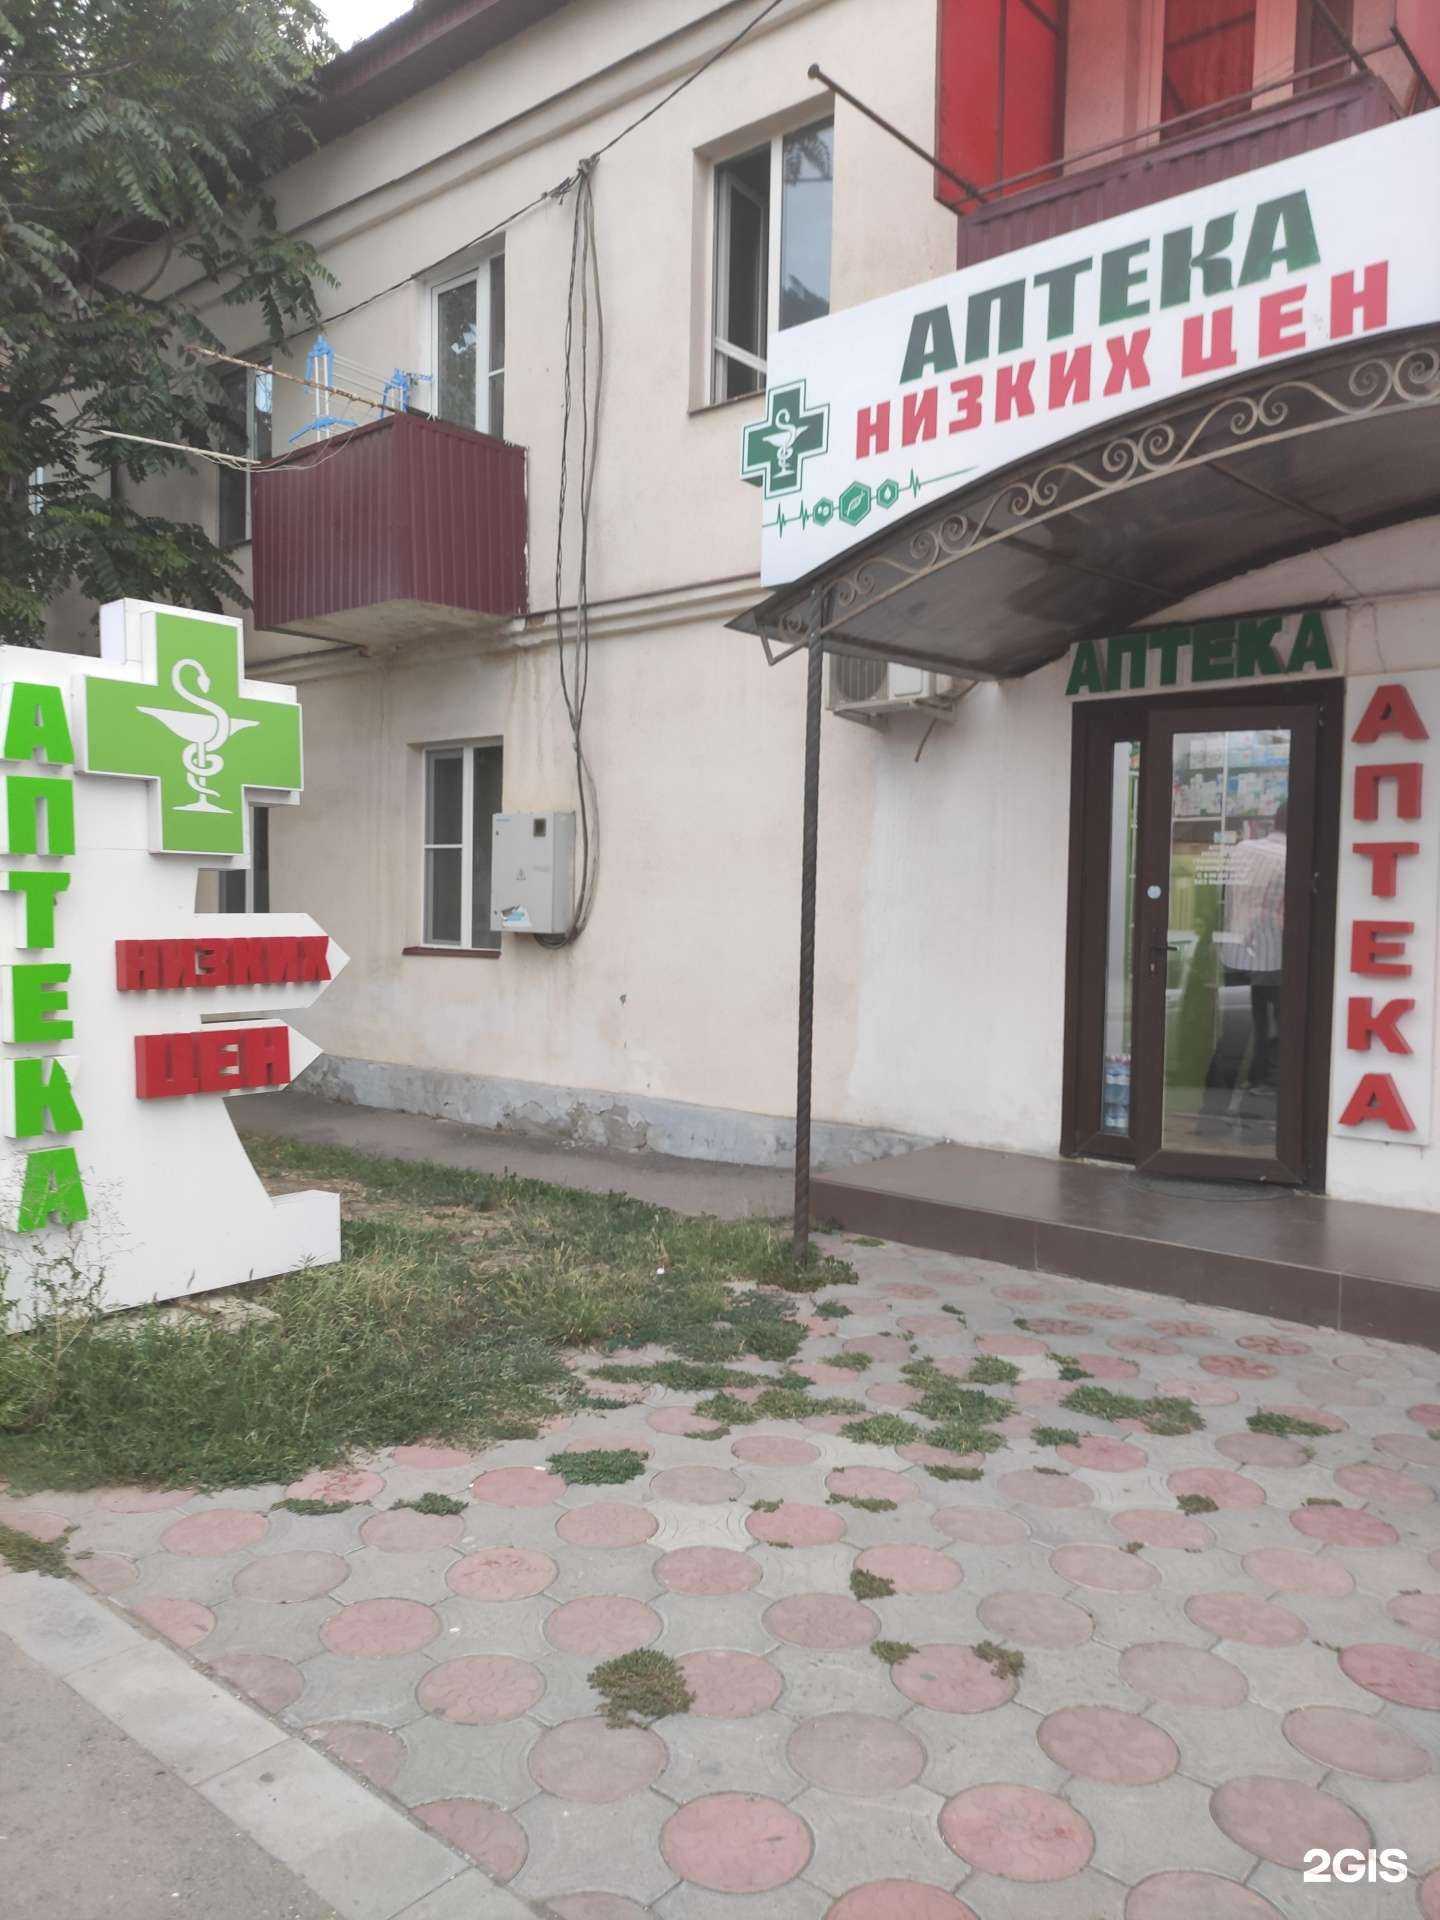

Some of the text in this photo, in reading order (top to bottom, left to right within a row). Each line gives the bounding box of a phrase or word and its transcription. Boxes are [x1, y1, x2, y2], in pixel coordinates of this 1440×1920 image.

[855, 260, 1389, 460] НИЗКИХ ЦЕН
[899, 188, 1321, 385] АПТЕКА
[1065, 611, 1333, 696] АПТЕКА
[2, 682, 88, 1234] АПТЕКА
[115, 936, 332, 992] НИЗКИХ
[1338, 683, 1429, 1132] АПТЕКА
[134, 1026, 291, 1099] ЦЕН
